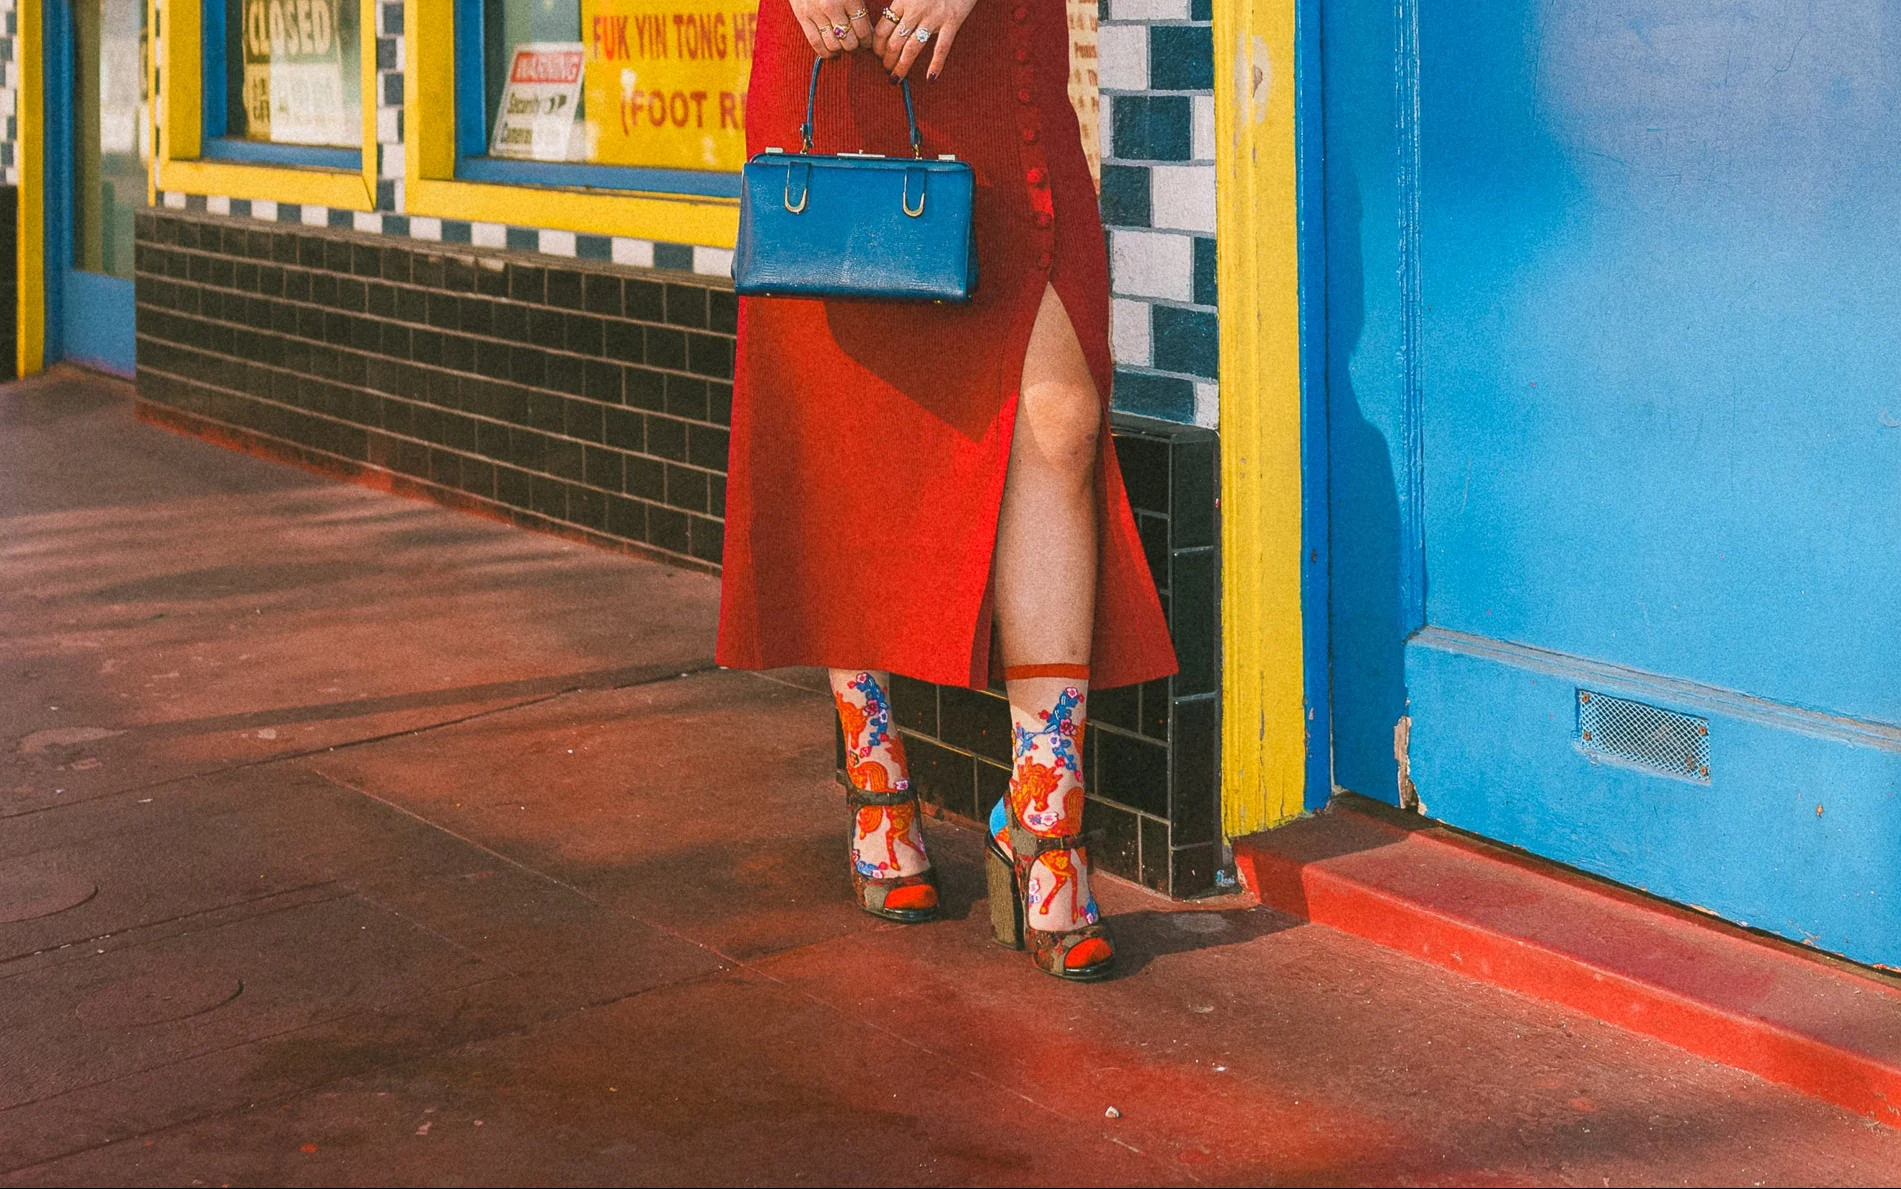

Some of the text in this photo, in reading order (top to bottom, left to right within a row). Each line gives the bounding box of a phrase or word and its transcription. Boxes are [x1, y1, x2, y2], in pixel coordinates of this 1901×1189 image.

[593, 15, 630, 59] FUK
[635, 13, 667, 58] YIN
[673, 12, 727, 59] TONG
[621, 88, 707, 136] (FOOT
